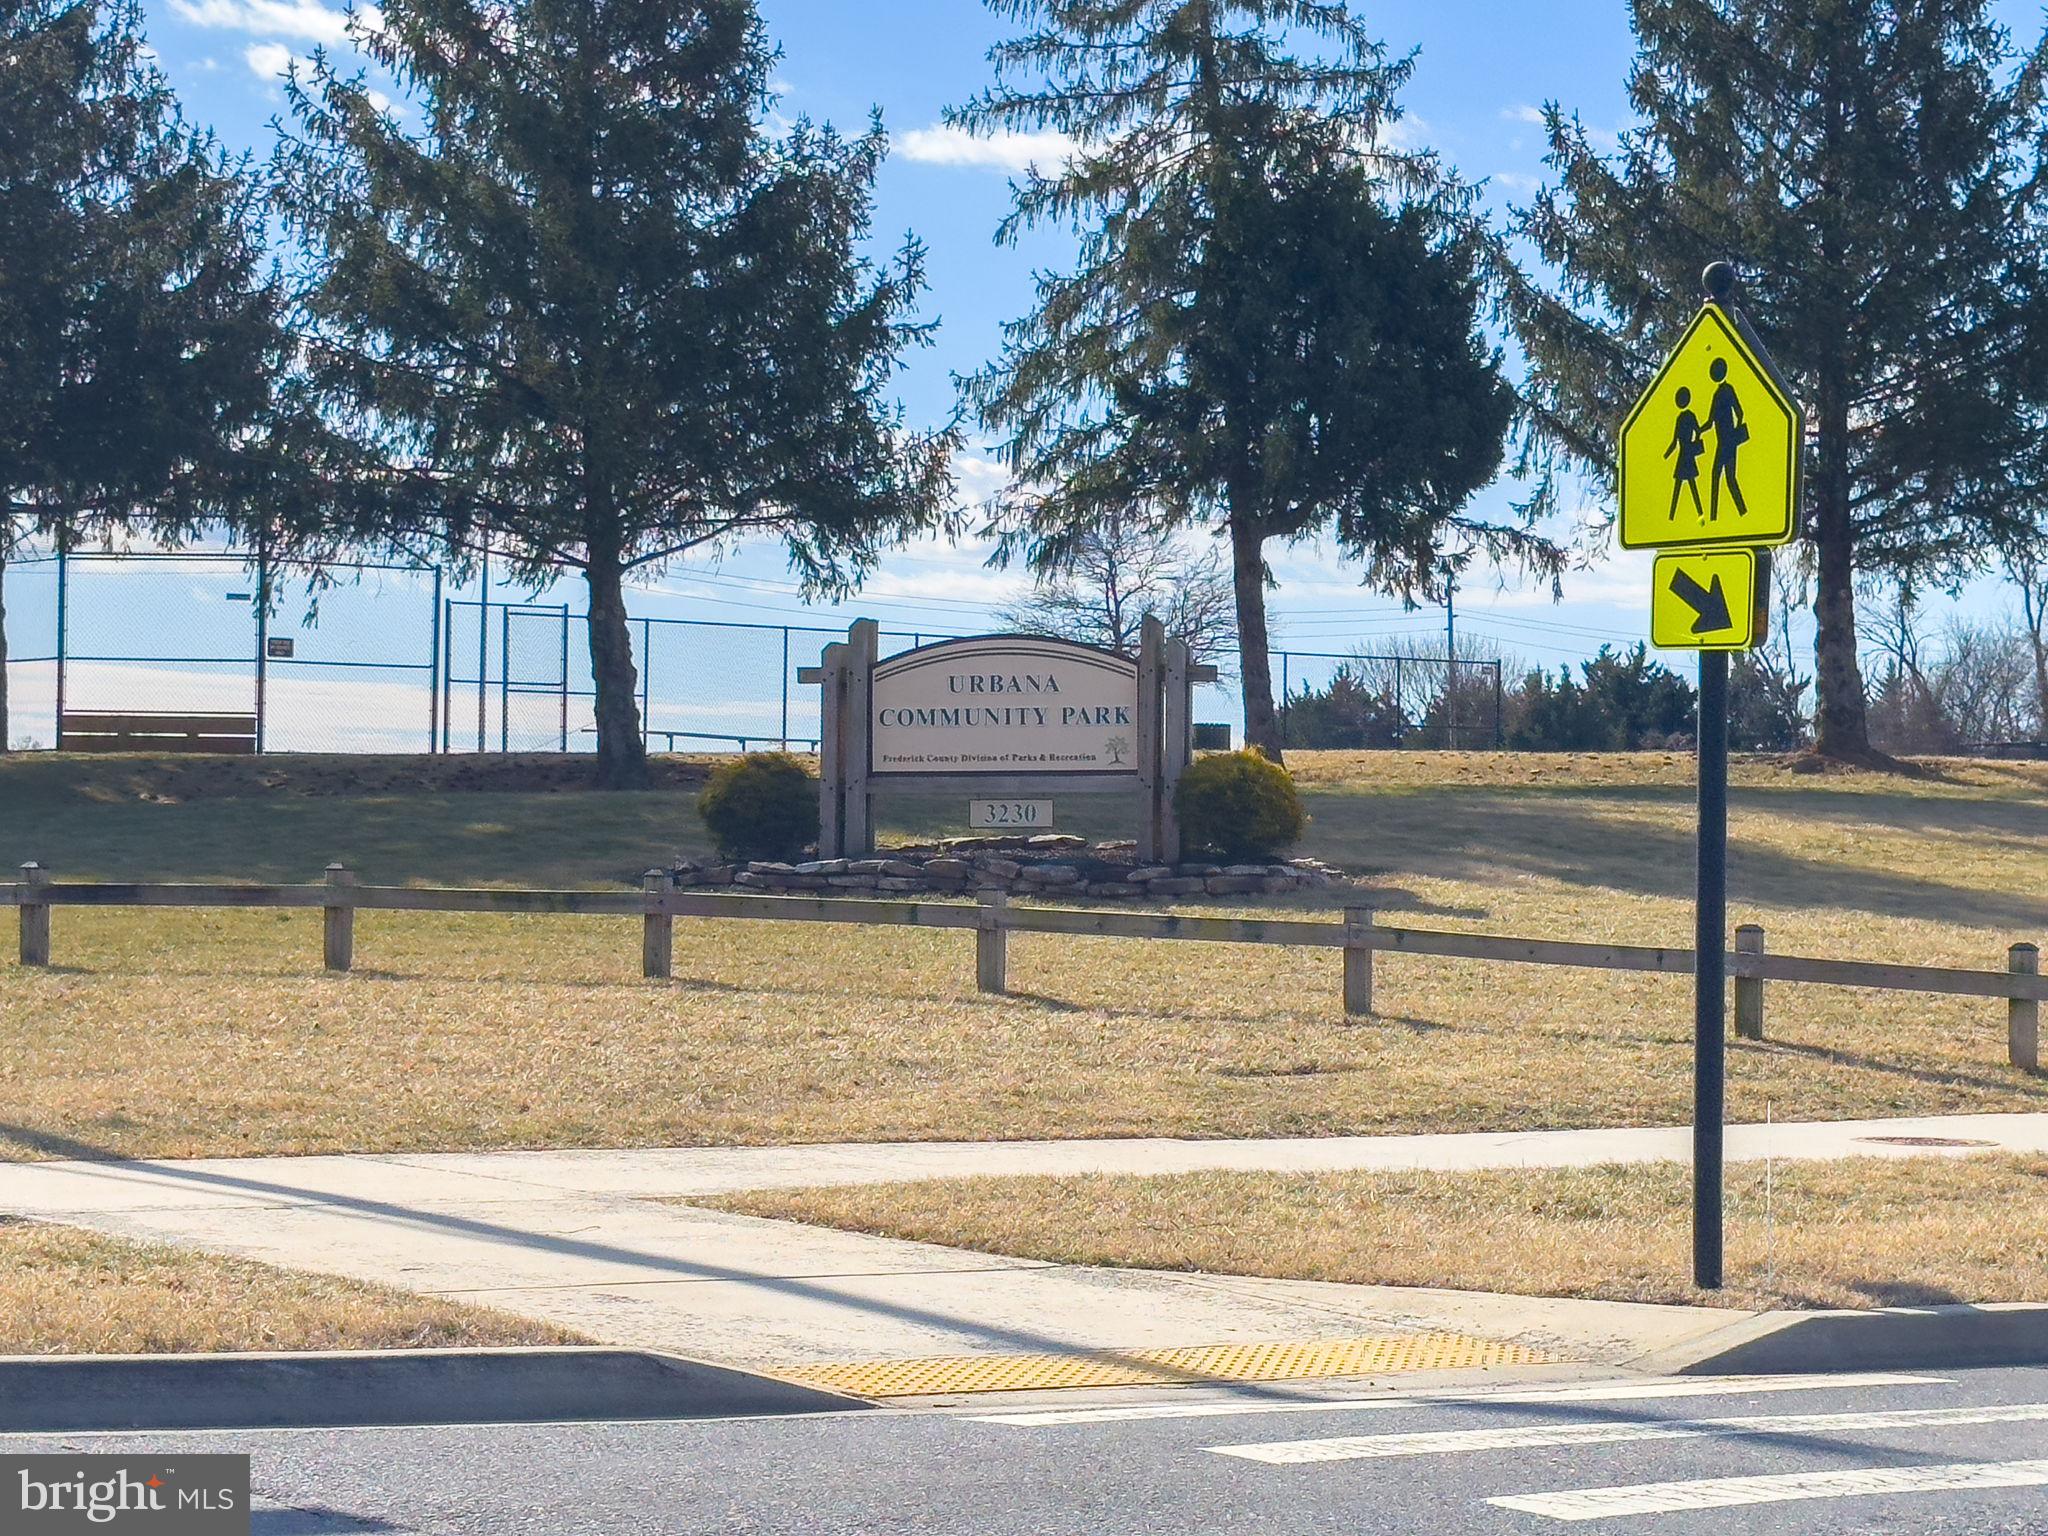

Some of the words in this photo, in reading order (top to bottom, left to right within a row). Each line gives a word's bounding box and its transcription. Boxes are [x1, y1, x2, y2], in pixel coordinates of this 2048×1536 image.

[948, 674, 1060, 694] URBANA
[879, 707, 1048, 727] COMMUNITY
[1062, 706, 1131, 725] PARK
[883, 754, 925, 763] Frederick
[927, 754, 959, 764] County
[961, 753, 998, 762] Division
[999, 753, 1010, 762] of
[1012, 753, 1037, 762] Parks
[1039, 753, 1047, 762] &
[1049, 752, 1097, 762] Recreation
[984, 804, 1037, 823] 3230
